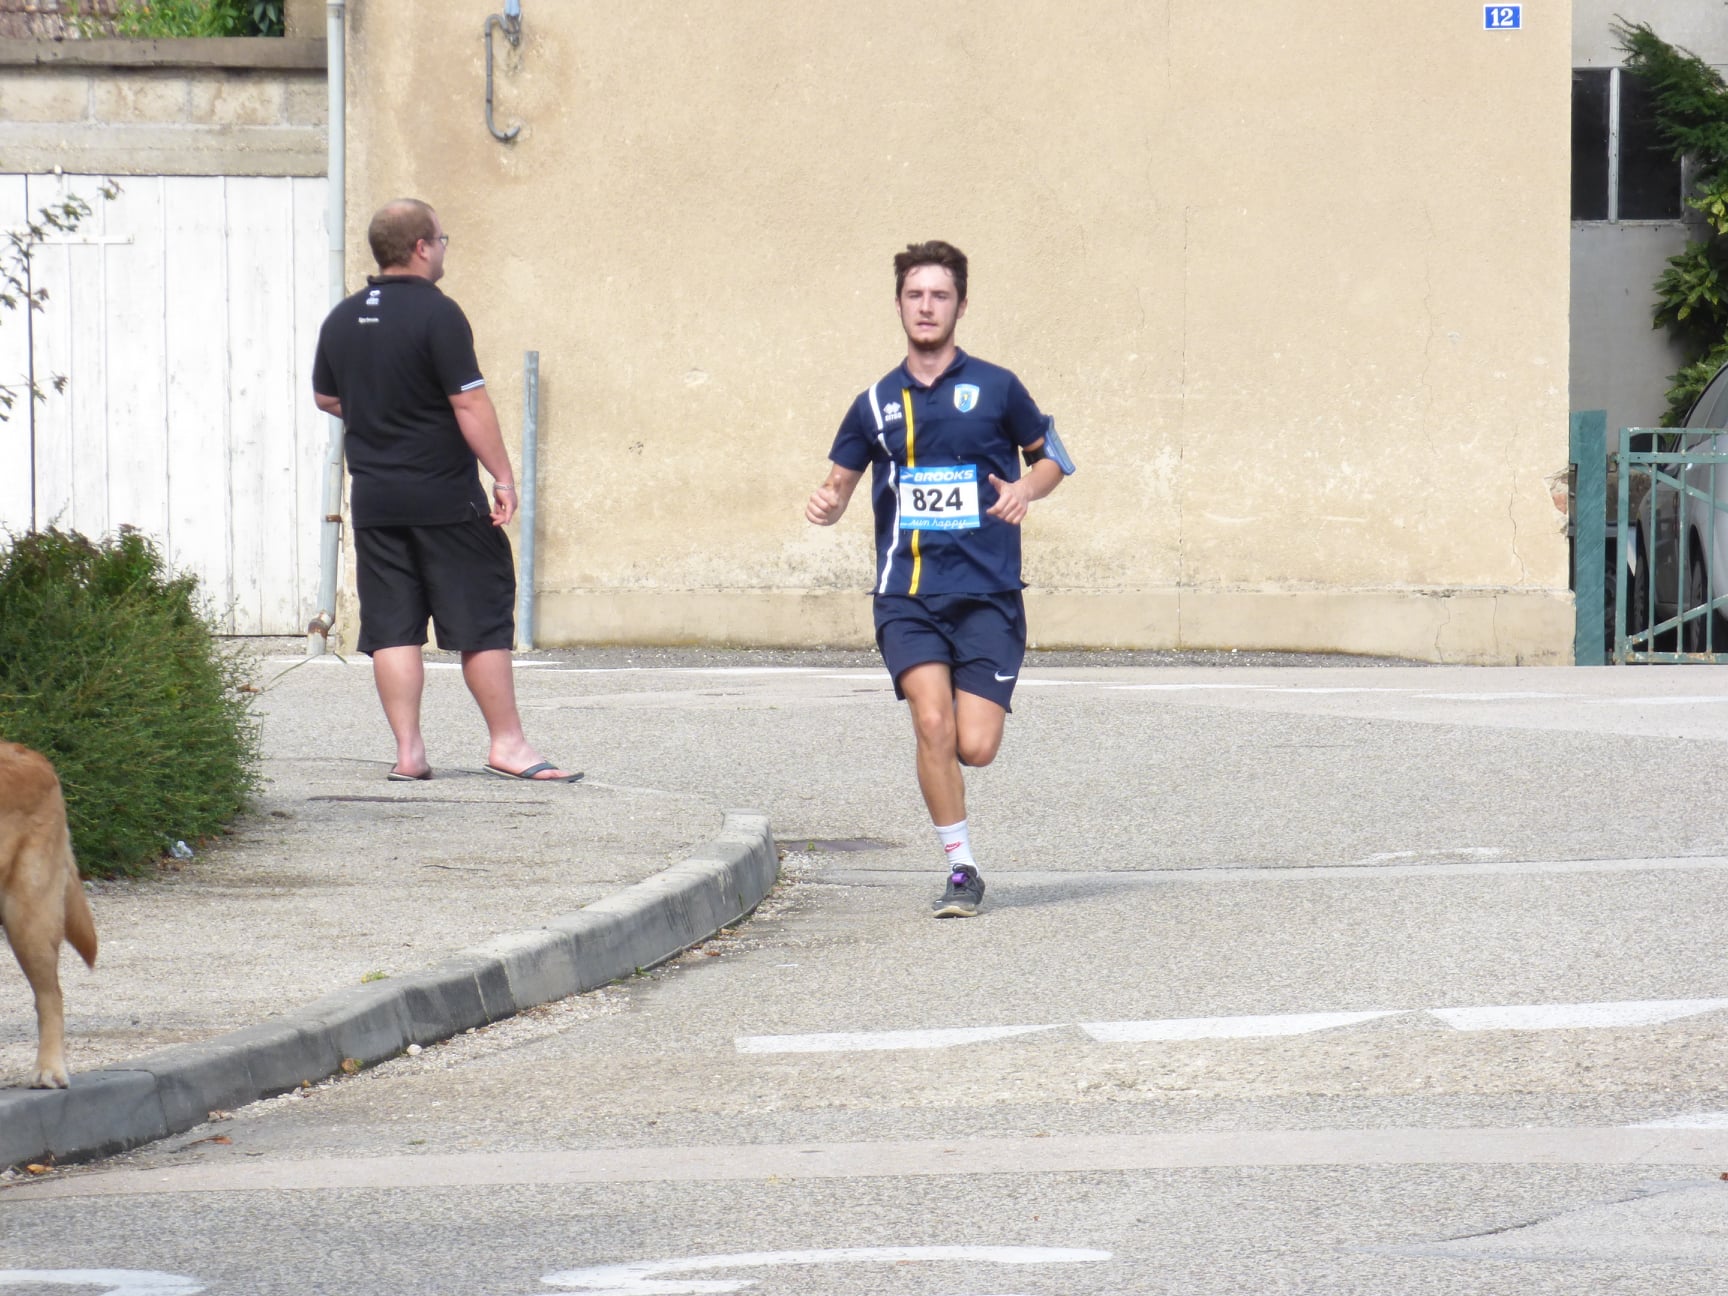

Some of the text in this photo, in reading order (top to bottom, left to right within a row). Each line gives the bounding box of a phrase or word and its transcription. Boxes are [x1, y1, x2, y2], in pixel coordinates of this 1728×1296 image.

[1490, 8, 1513, 26] 12
[914, 470, 973, 482] BROOKS
[912, 487, 963, 512] 824
[932, 518, 967, 529] happy
